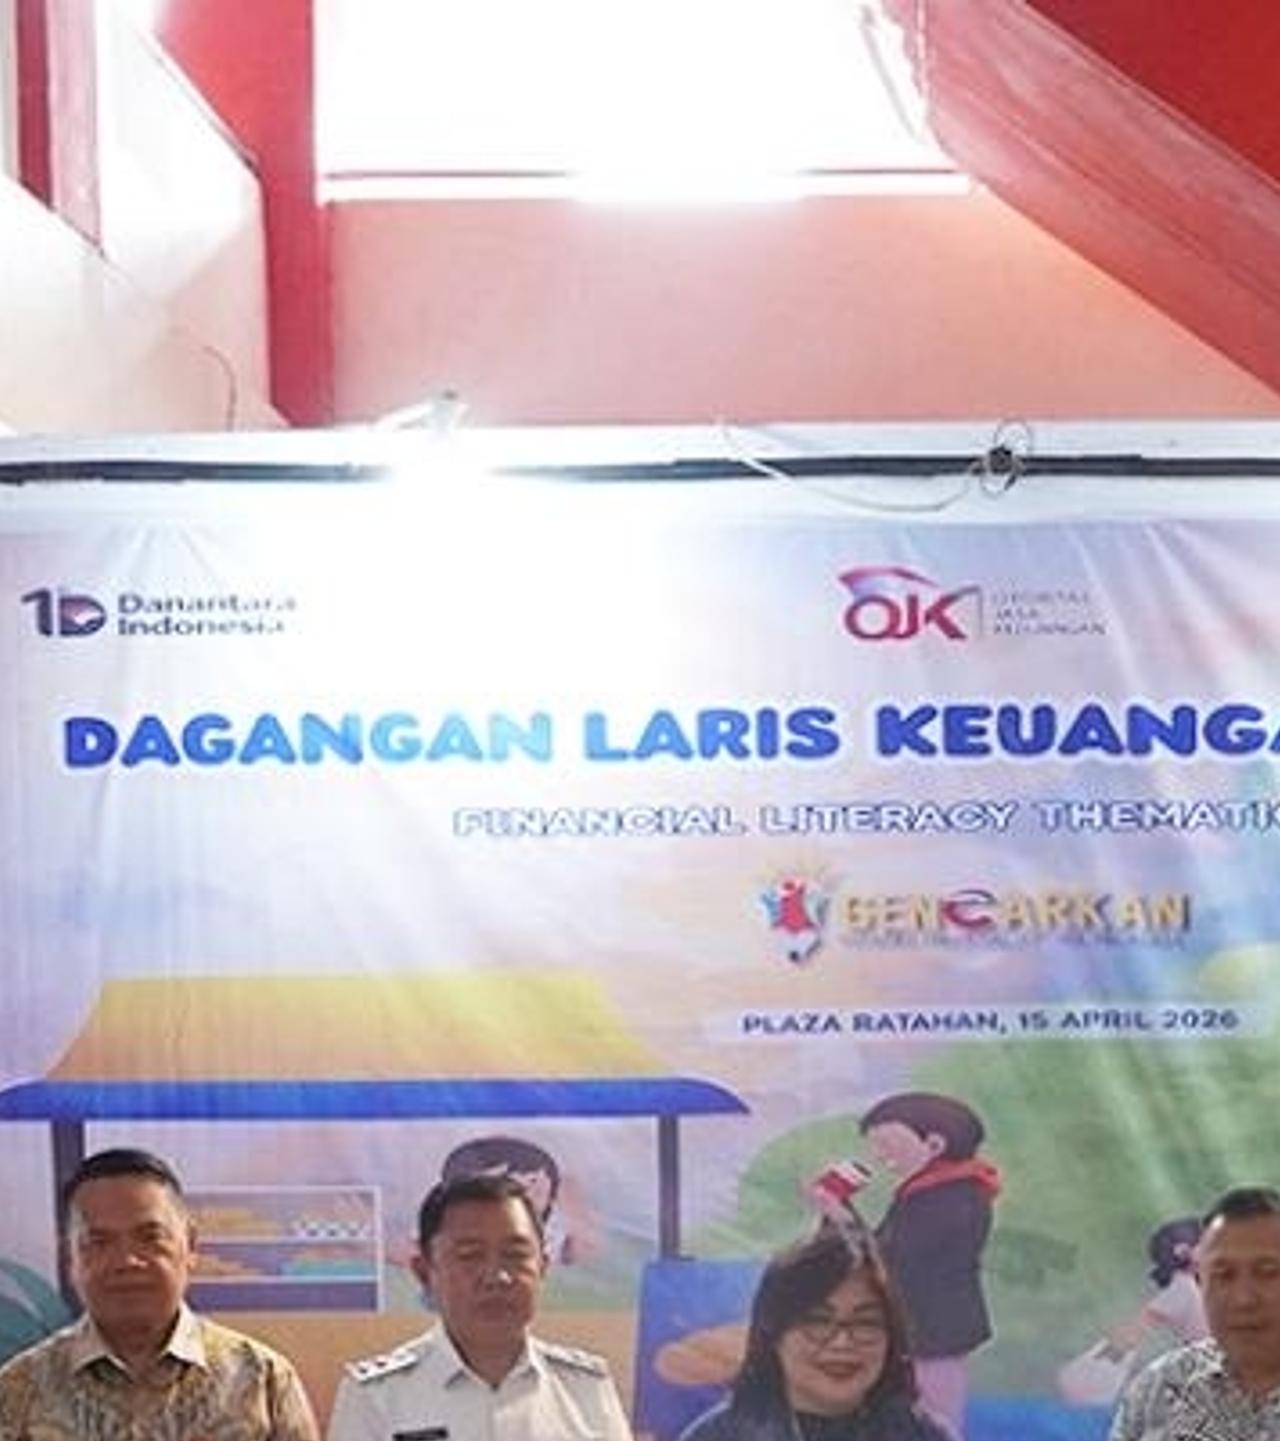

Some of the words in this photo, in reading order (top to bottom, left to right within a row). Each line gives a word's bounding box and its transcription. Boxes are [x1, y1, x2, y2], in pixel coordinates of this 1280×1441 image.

[62, 710, 554, 768] DAGANGAN
[585, 706, 840, 761] LARIS
[453, 806, 744, 838] FINANCIAL
[760, 802, 1017, 834] LITERACY
[743, 1012, 841, 1034] PLAZA
[852, 1011, 1008, 1035] RATAHAN,
[1018, 1010, 1050, 1031] 15
[1060, 1009, 1151, 1031] APRIL
[1161, 1008, 1240, 1031] 2026
